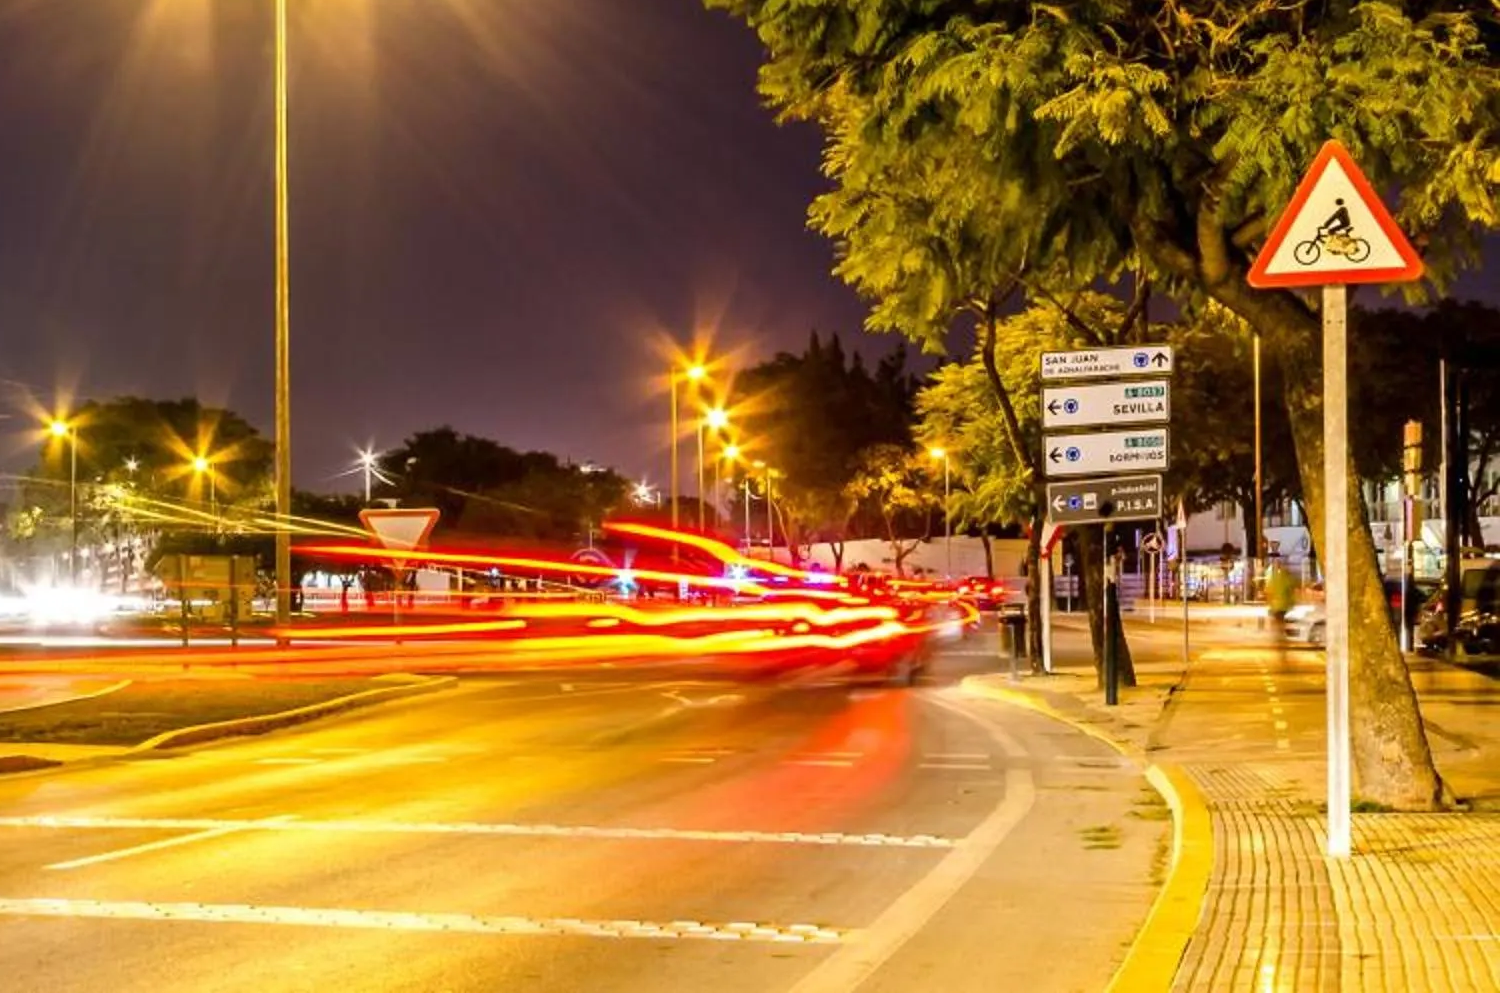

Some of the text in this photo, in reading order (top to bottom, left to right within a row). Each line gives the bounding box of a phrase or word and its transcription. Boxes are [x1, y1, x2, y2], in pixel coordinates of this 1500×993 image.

[1045, 354, 1099, 366] SAN JUAN
[1113, 402, 1164, 415] SEVILLA
